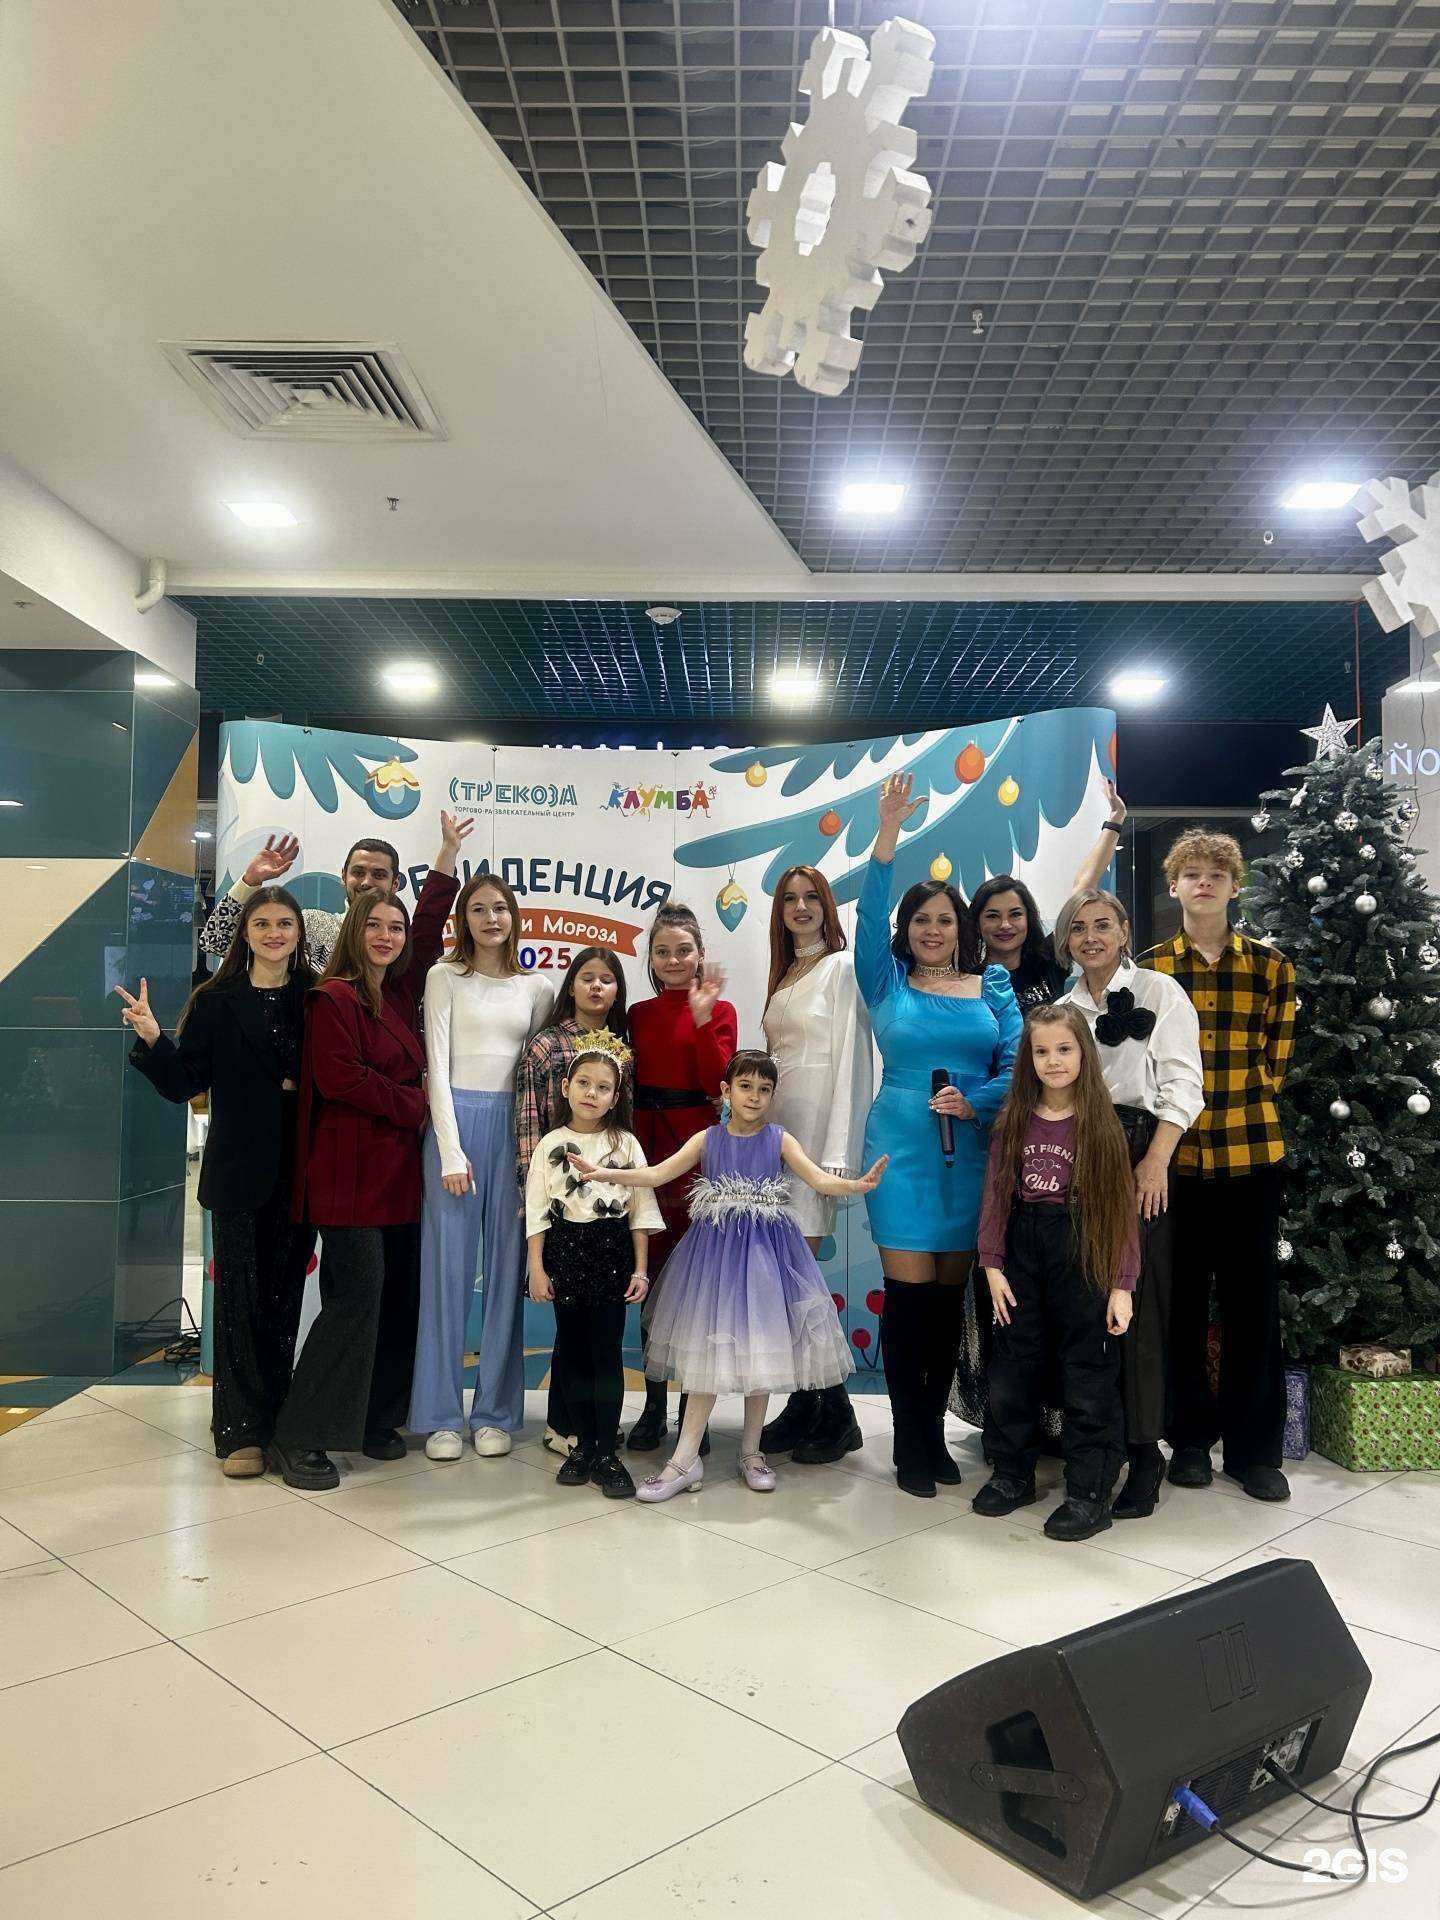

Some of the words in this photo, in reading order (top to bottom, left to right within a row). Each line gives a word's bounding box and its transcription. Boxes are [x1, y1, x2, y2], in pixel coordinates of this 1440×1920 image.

[600, 781, 718, 822] КЛУМБА
[552, 811, 575, 819] ЦЕНТР
[520, 946, 572, 970] 025
[1023, 1144, 1036, 1156] ST
[1025, 1173, 1060, 1192] Club
